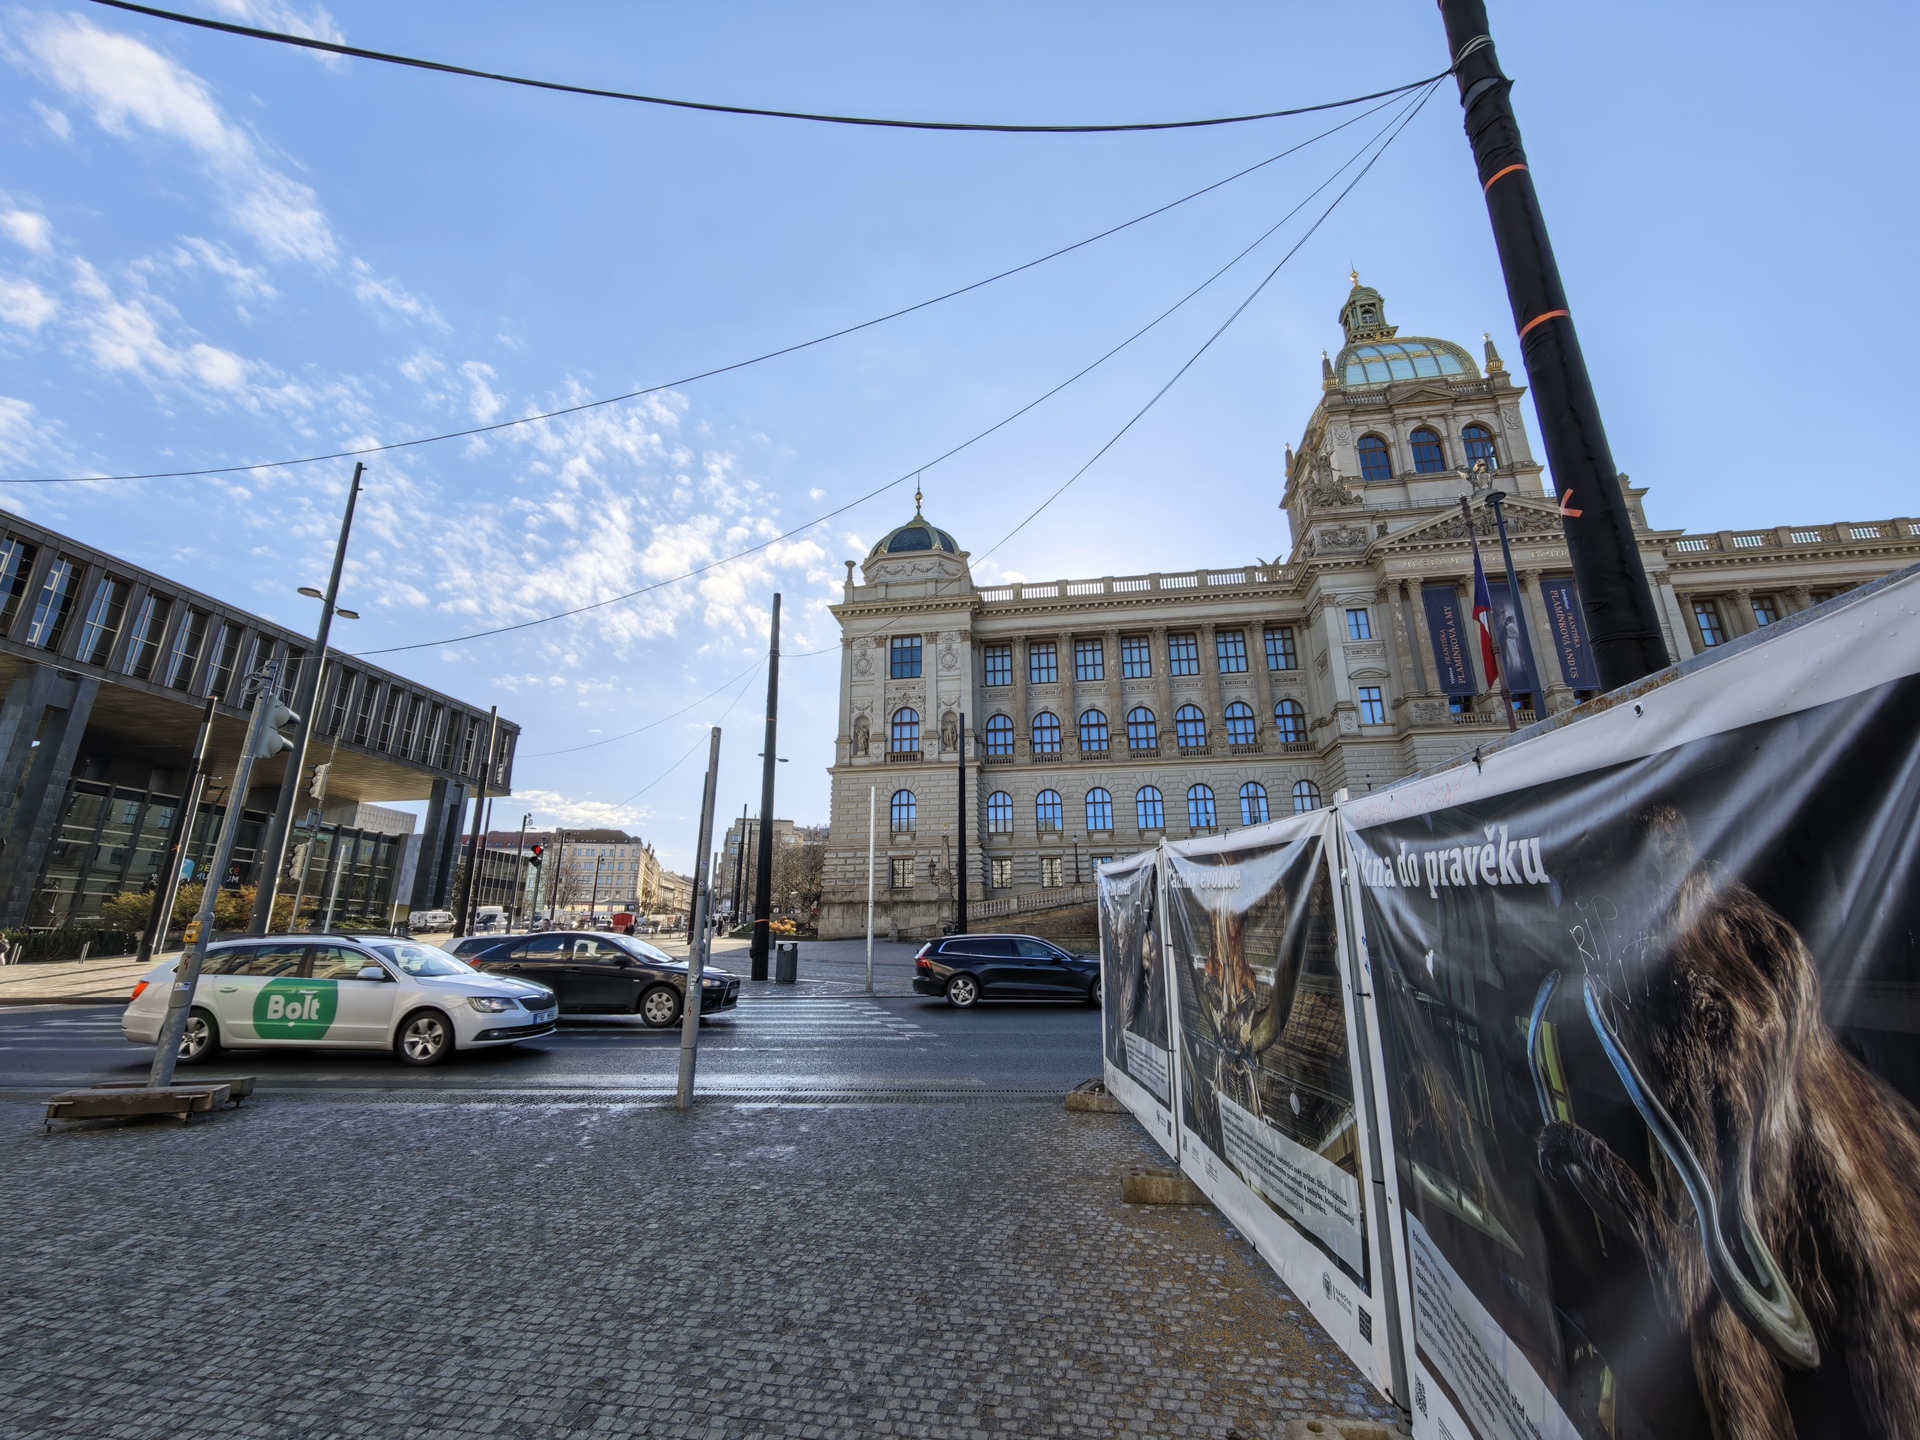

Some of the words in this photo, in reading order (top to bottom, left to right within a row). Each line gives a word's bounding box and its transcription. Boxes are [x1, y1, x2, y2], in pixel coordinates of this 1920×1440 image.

[1443, 606, 1453, 619] MY
[1550, 590, 1572, 645] PLAMÍNKOVÁ
[1446, 628, 1466, 684] PLAMÍNKOVÁ
[1564, 647, 1576, 666] AND
[1569, 667, 1579, 679] US
[1397, 842, 1420, 888] do
[1424, 824, 1550, 899] pravěku
[1201, 864, 1240, 890] evoluce
[266, 994, 321, 1020] Bolt
